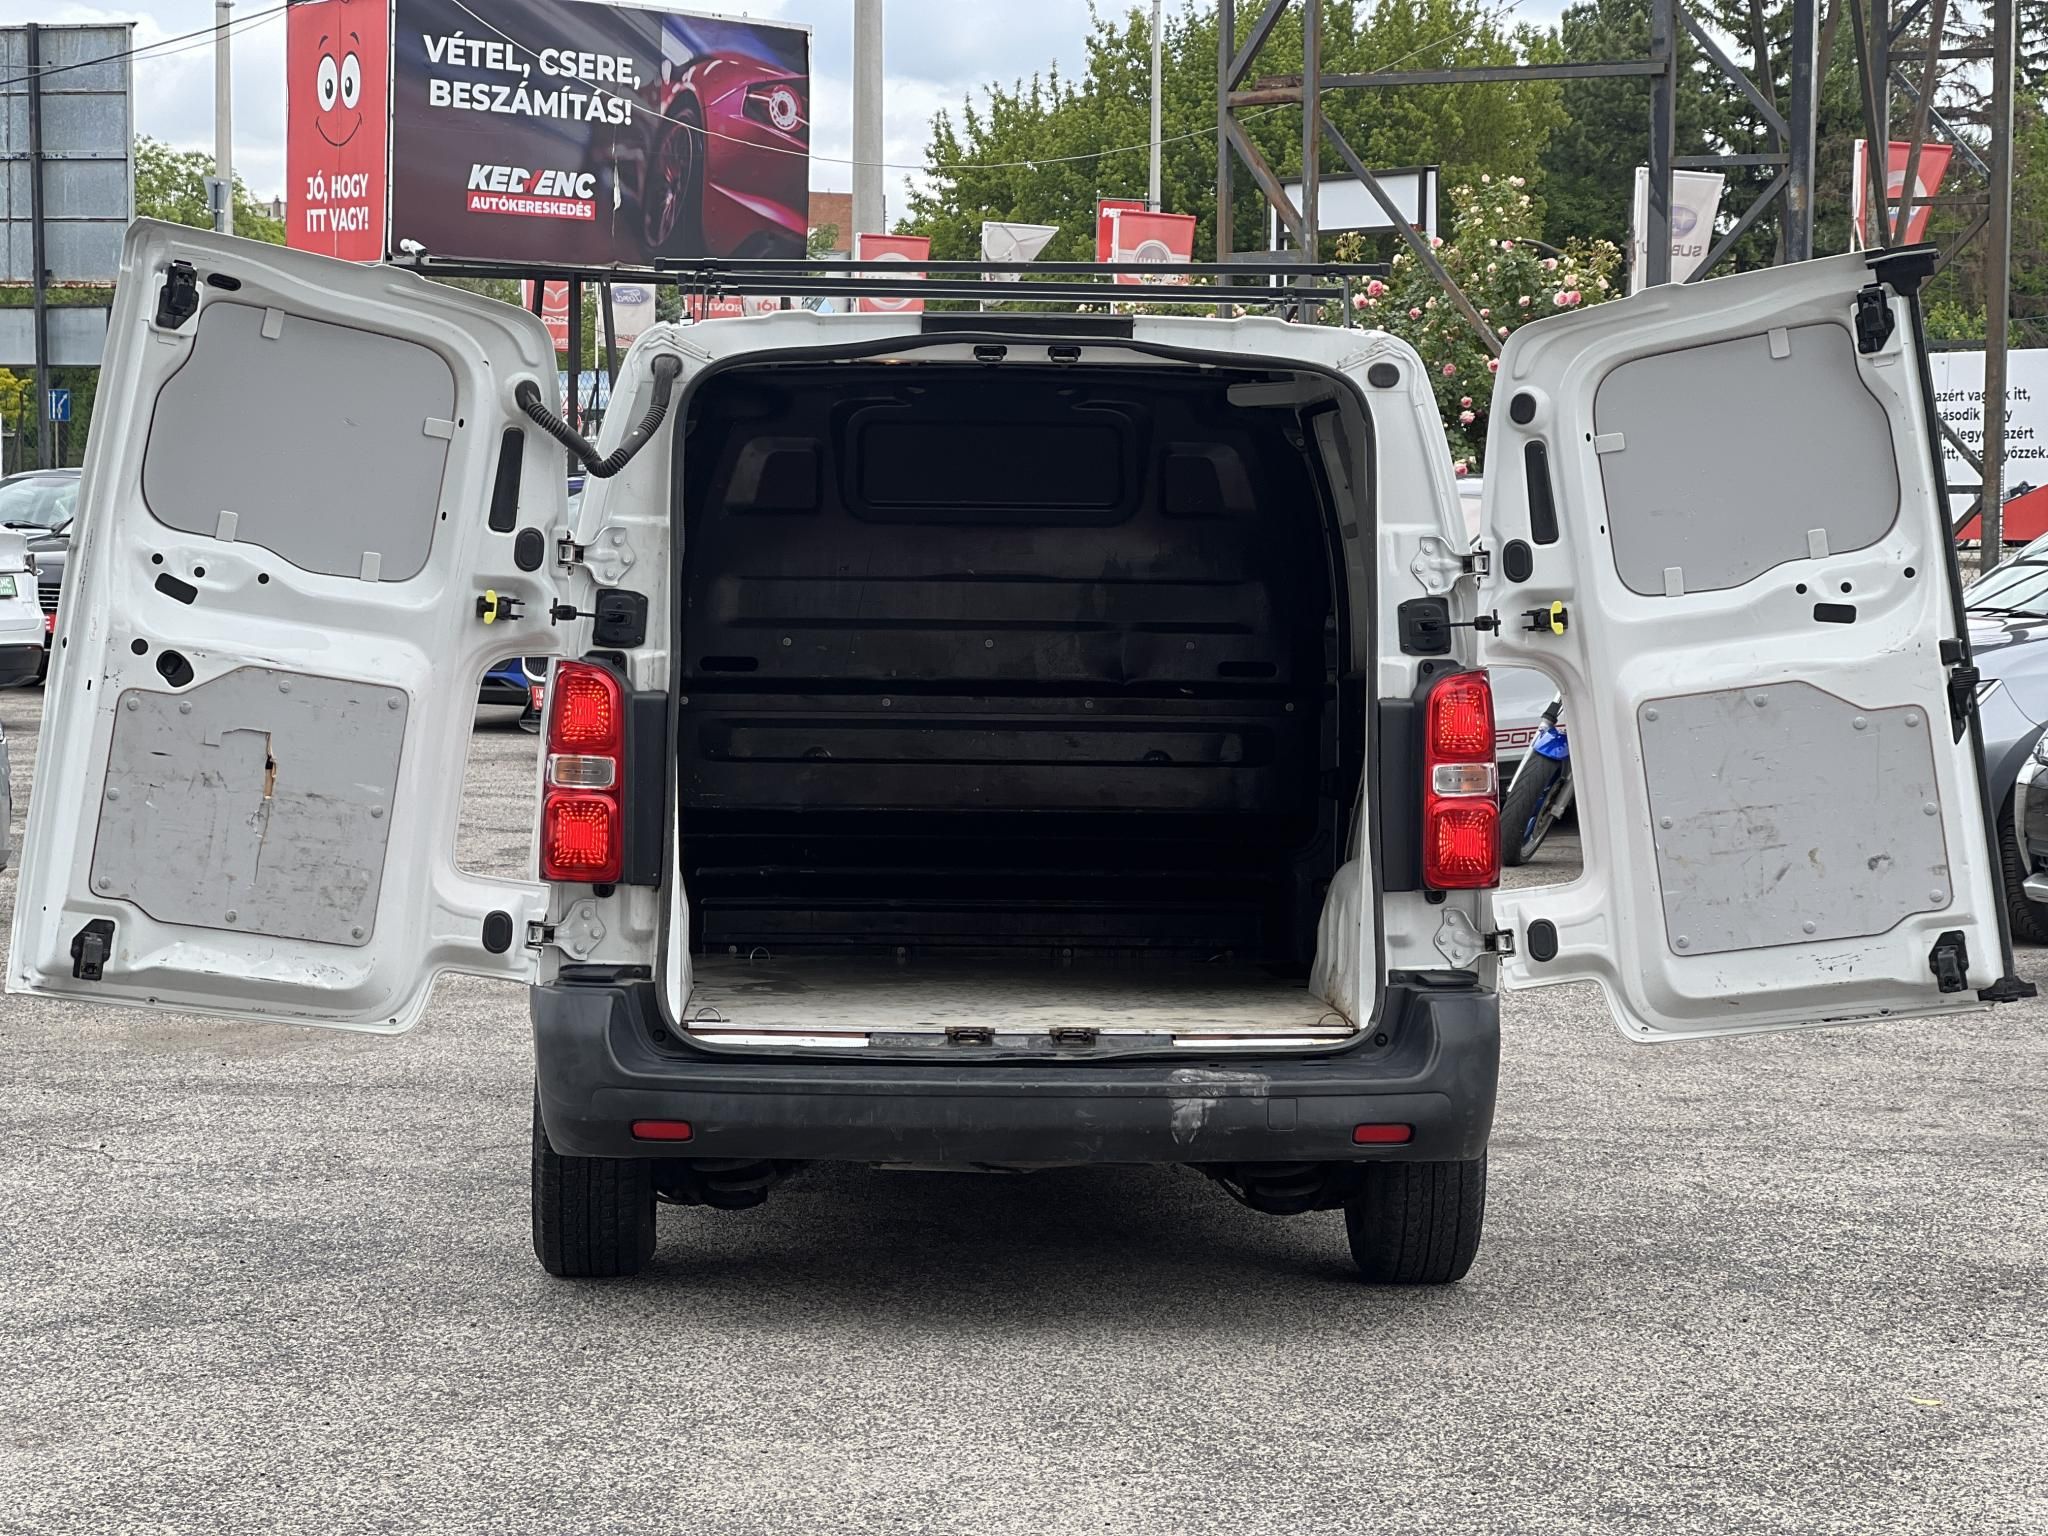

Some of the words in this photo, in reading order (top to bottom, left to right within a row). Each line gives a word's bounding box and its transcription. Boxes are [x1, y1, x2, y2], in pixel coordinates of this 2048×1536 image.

[423, 31, 531, 78] VÉTEL,
[538, 48, 641, 90] CSERE,
[429, 79, 633, 126] BESZÁMÍTÁS!
[306, 169, 328, 204] JÓ,
[331, 173, 369, 199] HOGY
[306, 208, 327, 233] ITT
[329, 206, 369, 232] VAGY!
[470, 195, 592, 218] AUTÓKERESKEDÉS
[1935, 388, 1964, 402] azért
[2013, 386, 2031, 402] itt,
[2004, 426, 2035, 439] azért
